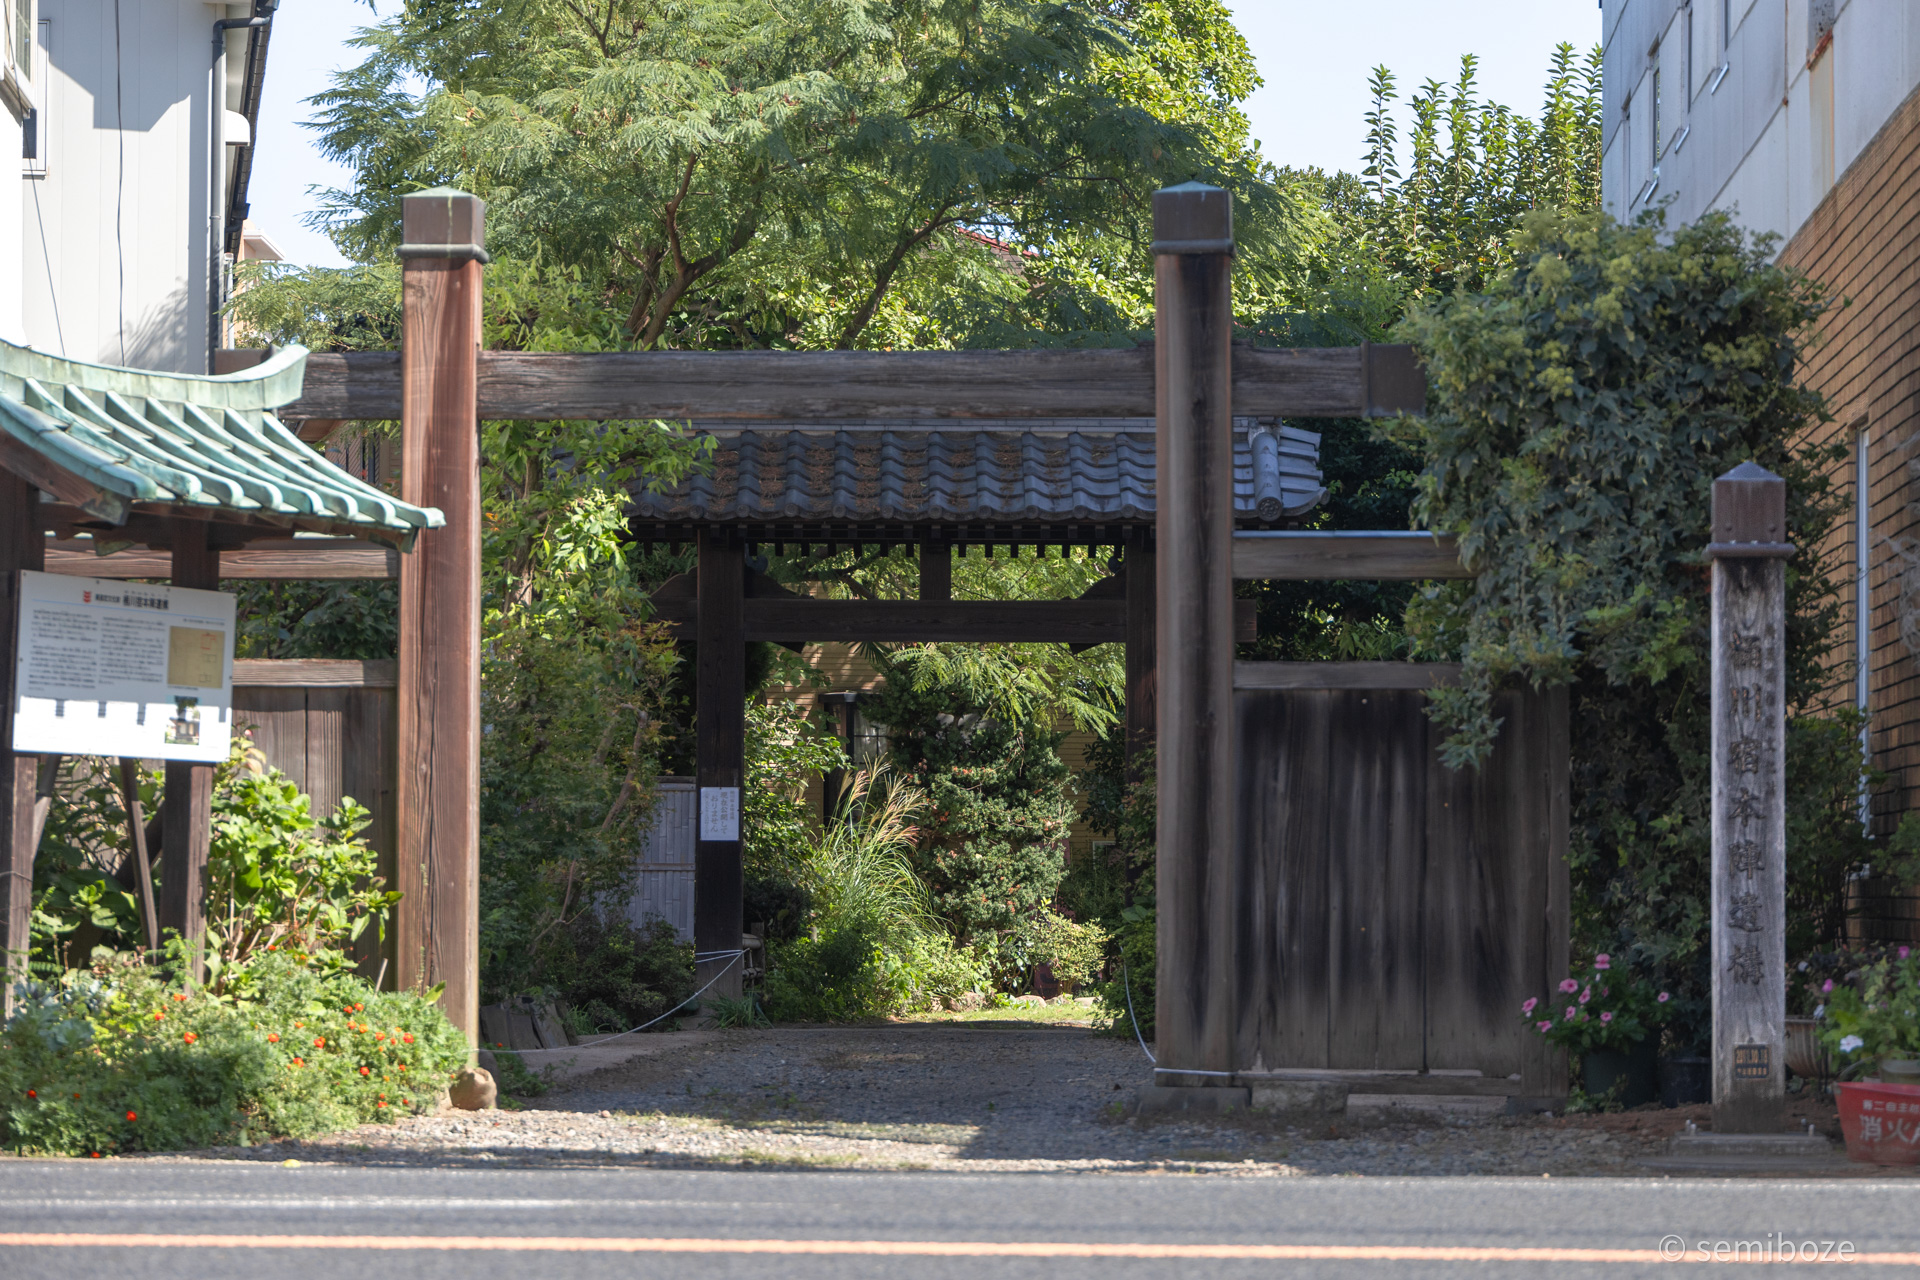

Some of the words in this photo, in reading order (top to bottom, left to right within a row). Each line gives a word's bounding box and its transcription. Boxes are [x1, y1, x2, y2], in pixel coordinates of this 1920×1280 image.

[710, 795, 718, 832] おりません
[720, 792, 728, 834] 現在公開して
[1727, 629, 1764, 986] 桶川宿本陣遺構
